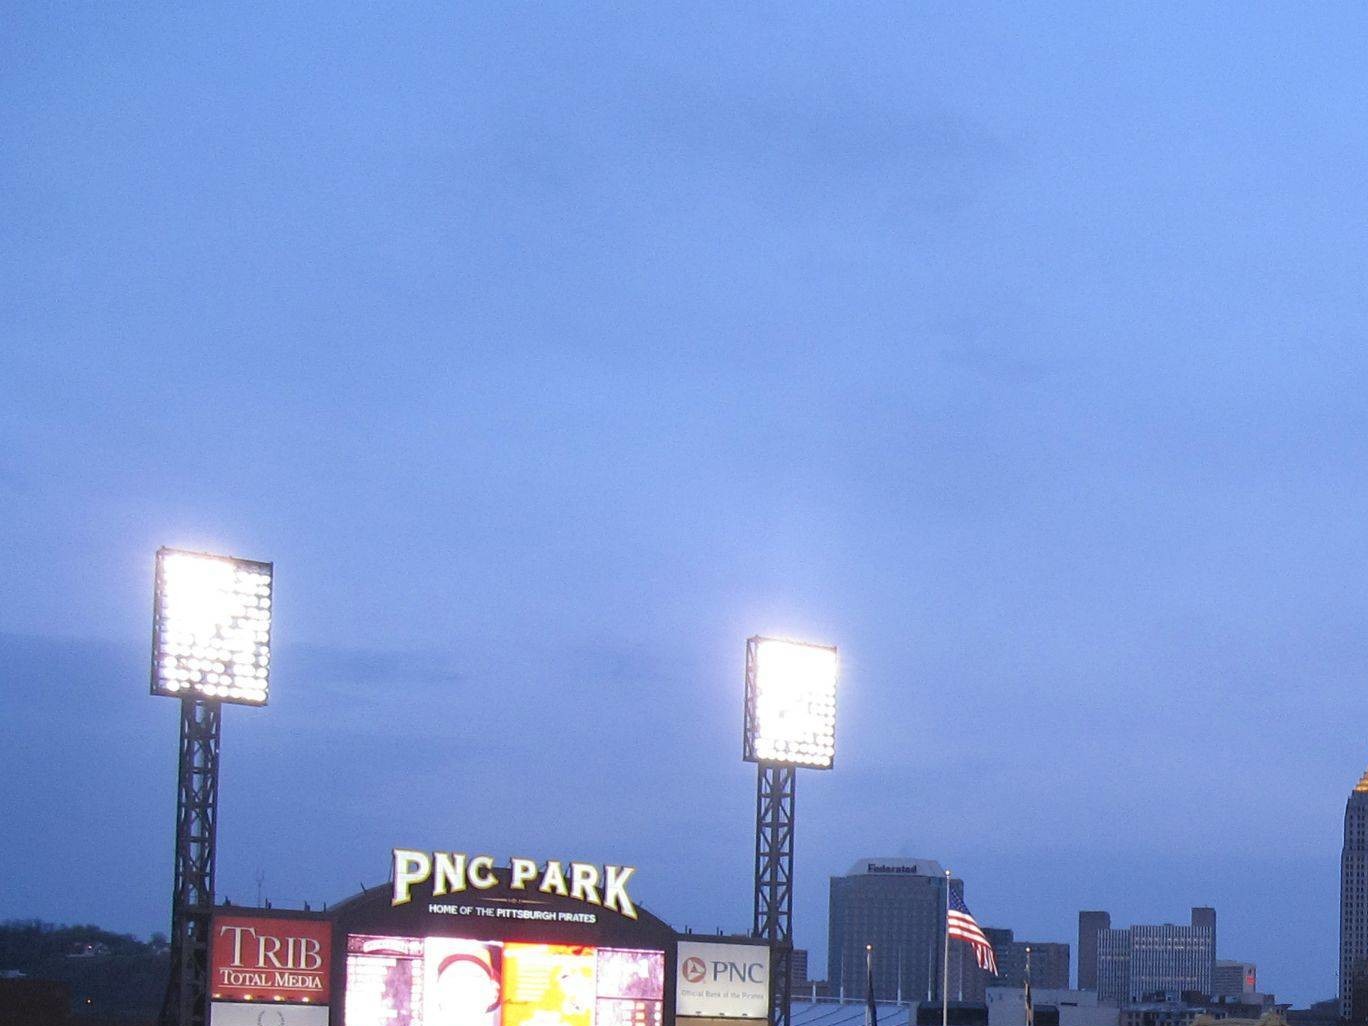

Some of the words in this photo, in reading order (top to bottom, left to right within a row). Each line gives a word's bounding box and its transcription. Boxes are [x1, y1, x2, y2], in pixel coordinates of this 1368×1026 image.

[391, 848, 499, 907] PNC
[509, 857, 639, 921] PARK
[429, 904, 458, 915] HOME
[459, 906, 473, 916] OF
[475, 907, 495, 917] THE
[496, 909, 556, 921] PITTSBURGH
[558, 912, 596, 924] PIRATES
[220, 926, 322, 970] TRIB
[220, 969, 271, 987] TOTAL
[274, 972, 322, 988] MEDIA
[710, 960, 764, 983] PNC
